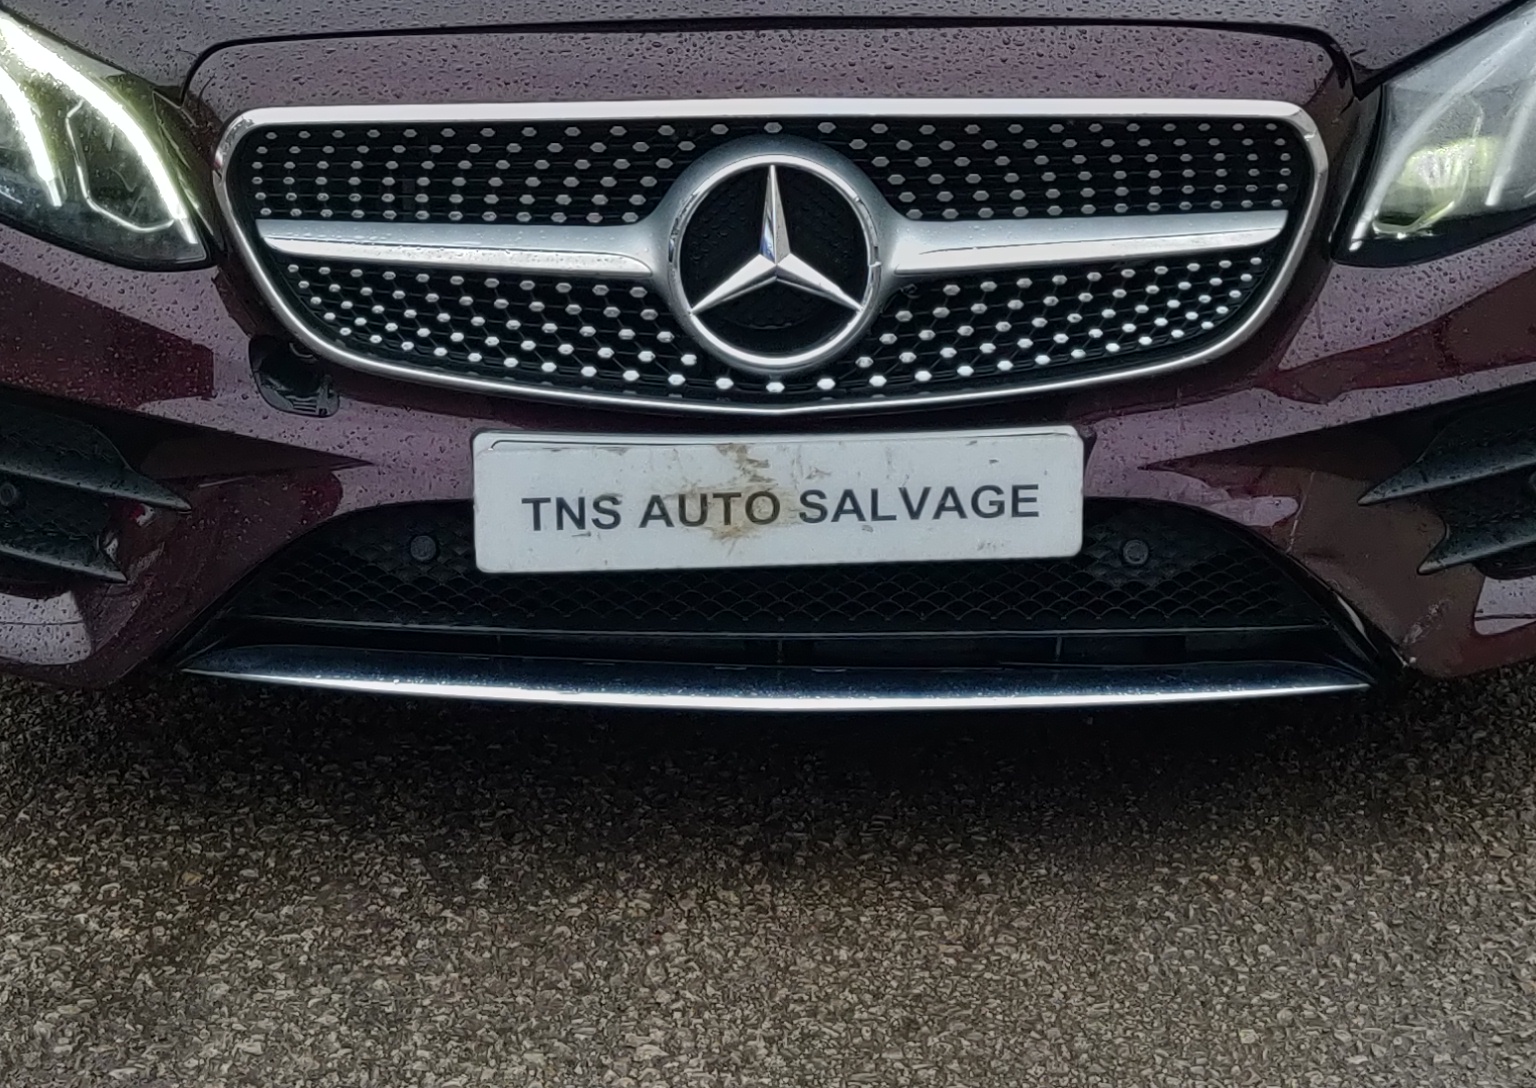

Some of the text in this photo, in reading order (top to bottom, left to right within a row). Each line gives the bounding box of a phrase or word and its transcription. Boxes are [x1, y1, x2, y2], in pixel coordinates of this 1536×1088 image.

[522, 483, 1040, 532] TNS AUTO SALVAGE
